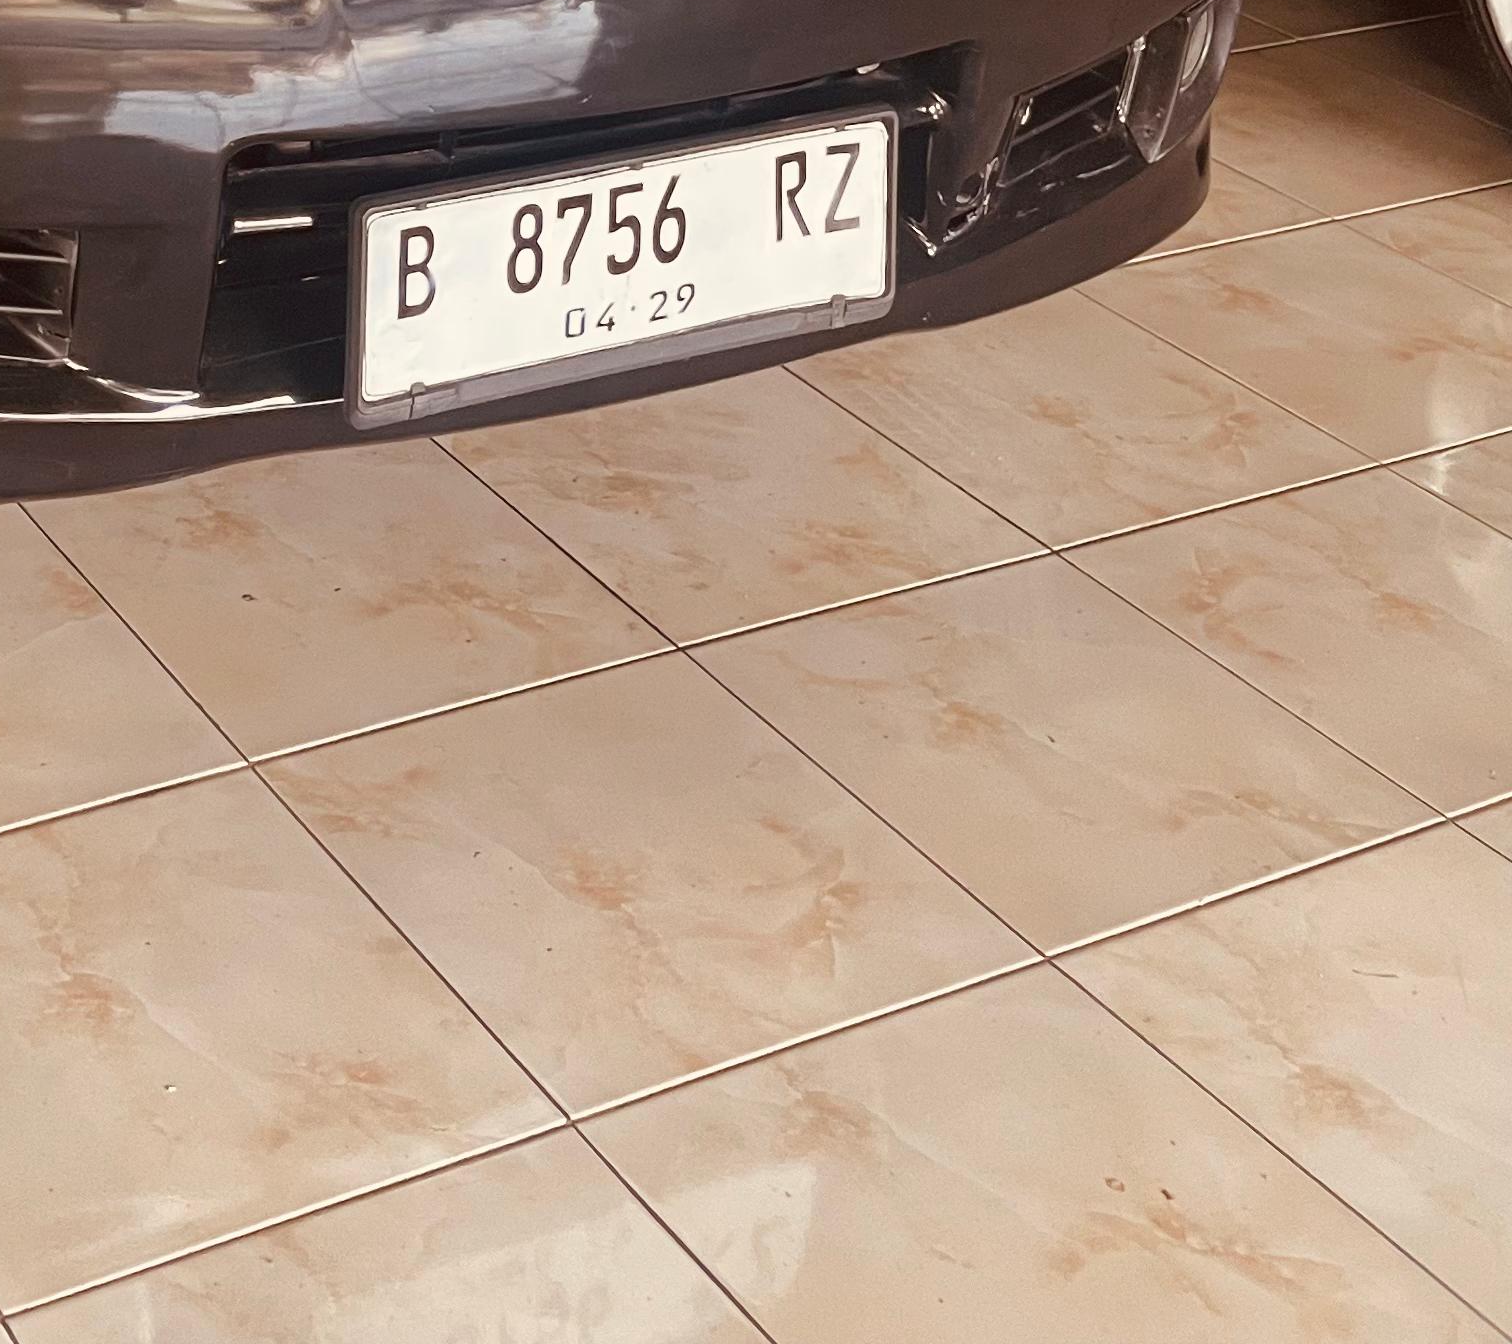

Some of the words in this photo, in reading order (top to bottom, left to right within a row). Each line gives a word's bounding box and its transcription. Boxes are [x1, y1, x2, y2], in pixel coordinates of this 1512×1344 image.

[399, 226, 436, 319] B
[506, 174, 688, 294] 8756
[775, 143, 862, 242] RZ
